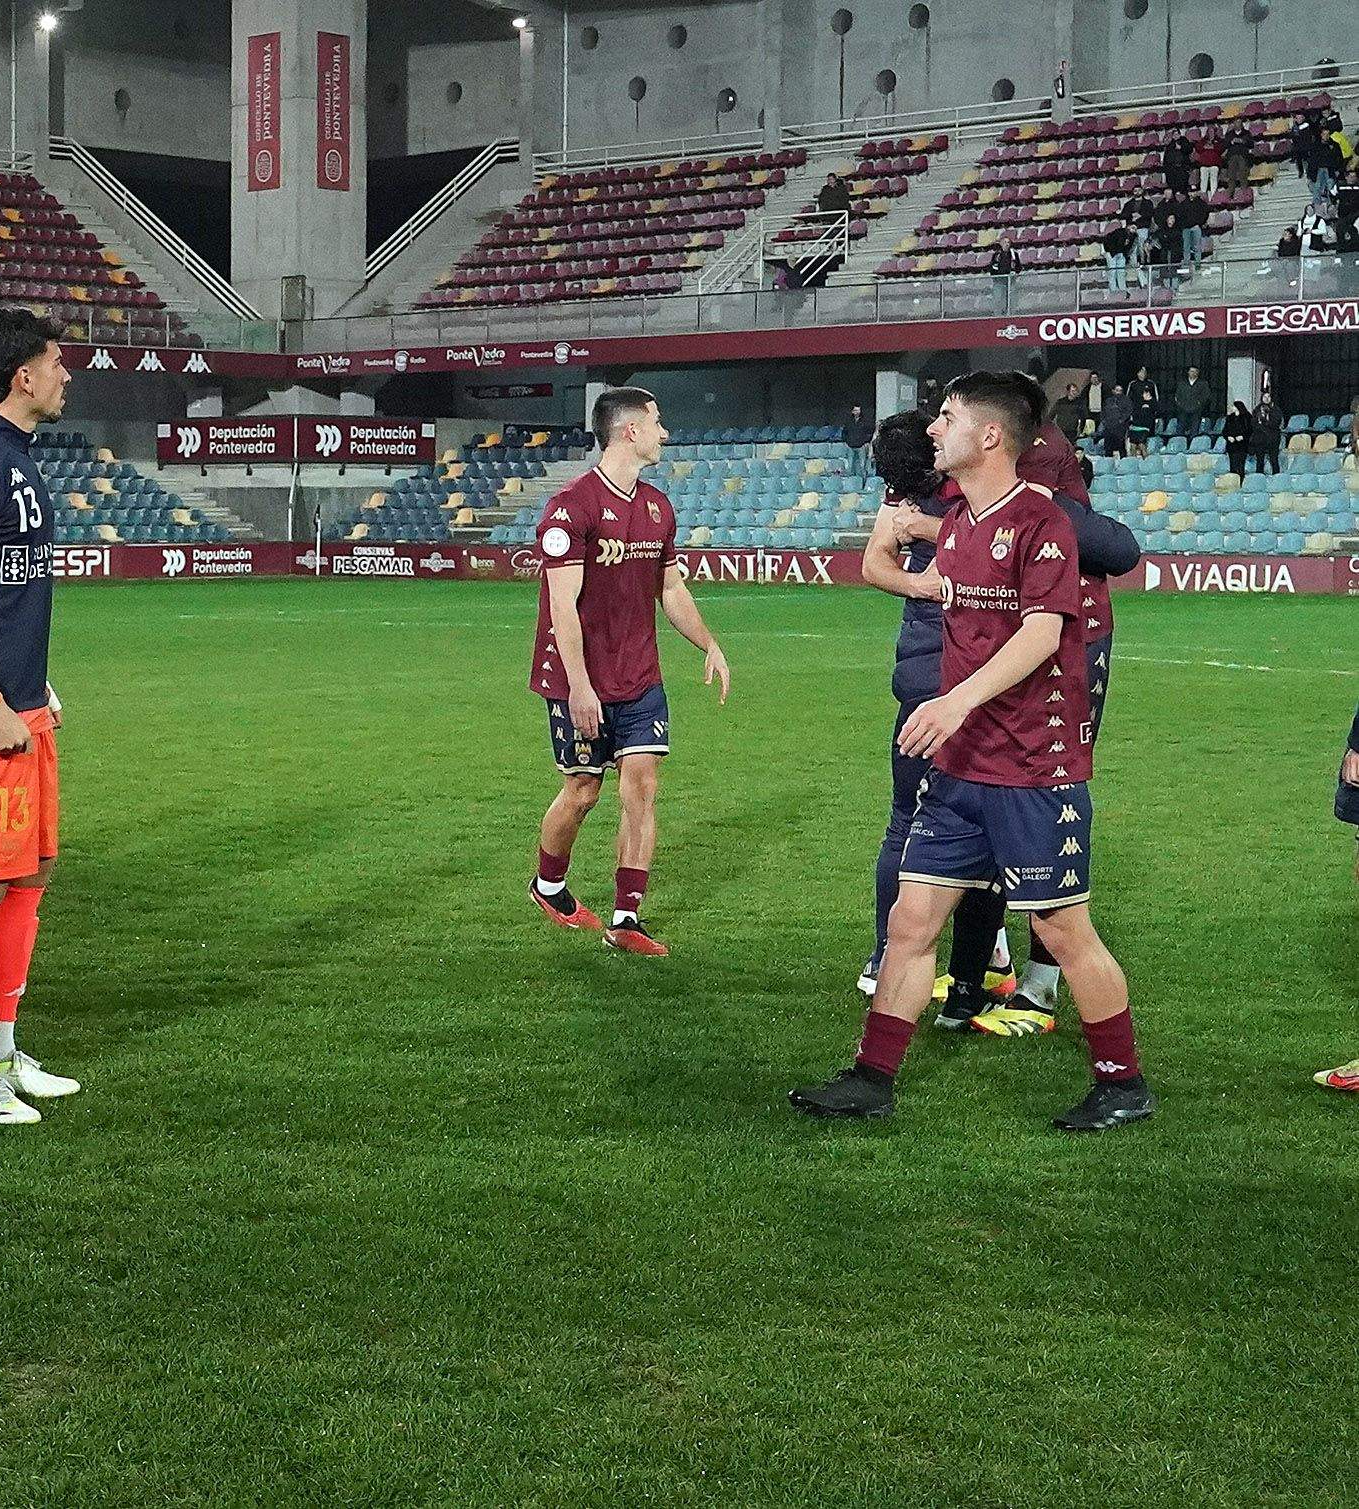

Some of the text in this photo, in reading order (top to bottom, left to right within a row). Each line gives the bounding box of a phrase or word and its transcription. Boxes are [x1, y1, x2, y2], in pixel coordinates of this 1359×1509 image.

[262, 43, 273, 140] PONTEVEDRA
[332, 44, 342, 140] PONTEVEDRA
[1038, 312, 1206, 342] CONSERVAS
[209, 424, 275, 442] Deputación
[350, 425, 416, 443] Deputación
[209, 442, 275, 455] Pontevedra
[350, 442, 416, 456] Pontevedra
[11, 485, 43, 533] 13
[192, 548, 252, 562] Deputación
[352, 546, 395, 556] CONSERVAS
[192, 562, 252, 574] Pontevedra
[332, 556, 415, 576] PESCAMAR
[675, 553, 834, 585] SANIFAX
[1170, 562, 1296, 593] ViAQUA
[956, 583, 1018, 598] Deputación
[956, 596, 1019, 611] Pontevedra
[1021, 866, 1054, 875] DEPORTE
